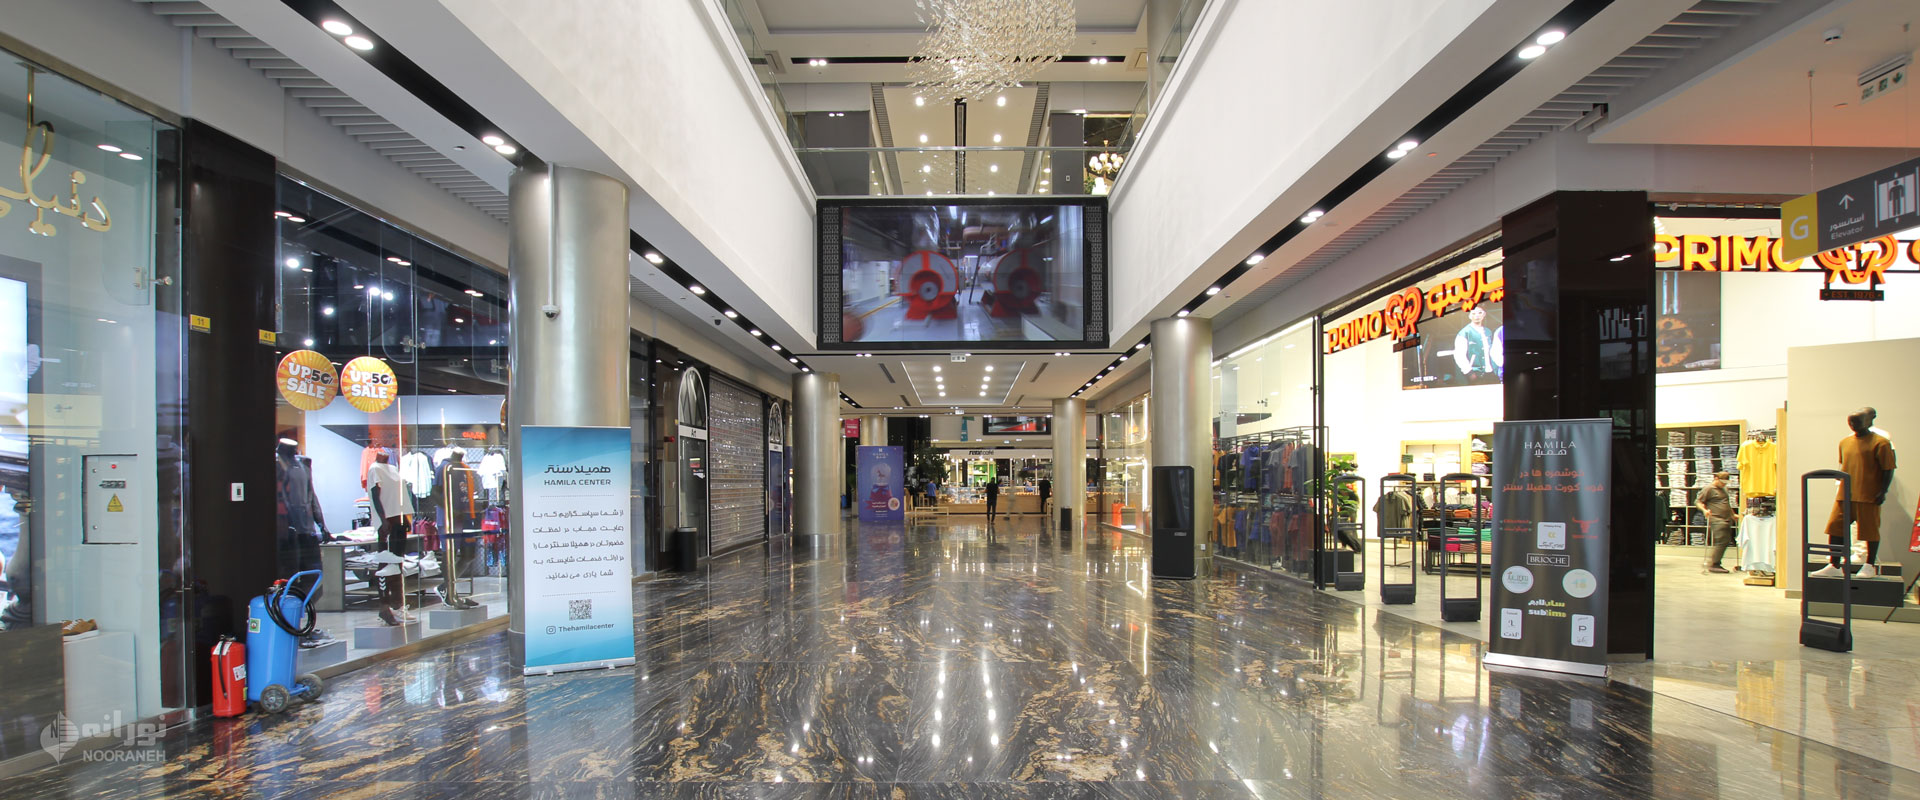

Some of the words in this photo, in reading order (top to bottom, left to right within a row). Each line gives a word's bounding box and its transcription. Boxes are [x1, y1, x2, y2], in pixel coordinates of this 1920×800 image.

[1790, 215, 1809, 240] G
[1830, 226, 1864, 240] Elevator
[1327, 310, 1383, 355] PRIMO
[288, 361, 311, 379] UP
[349, 369, 372, 383] UP
[286, 377, 327, 400] SALE
[351, 383, 388, 399] SALE
[1524, 440, 1577, 449] HAMILA
[1534, 448, 1567, 458] همیلا
[1519, 469, 1529, 479] در
[1531, 468, 1542, 477] ها
[1502, 483, 1523, 493] سنتر
[1525, 483, 1552, 493] همیلا
[600, 508, 619, 517] شما
[532, 526, 561, 534] لحظات
[572, 525, 597, 533] حجاب
[599, 524, 624, 532] رعایت
[549, 541, 570, 550] سنتر
[570, 540, 589, 549] همیلا
[595, 540, 624, 548] حضورتان
[546, 555, 576, 565] شایسته
[576, 555, 602, 563] خدمات
[1530, 556, 1567, 565] BRIOCHE
[600, 569, 614, 577] شما
[558, 623, 615, 632] Thehamilacenter
